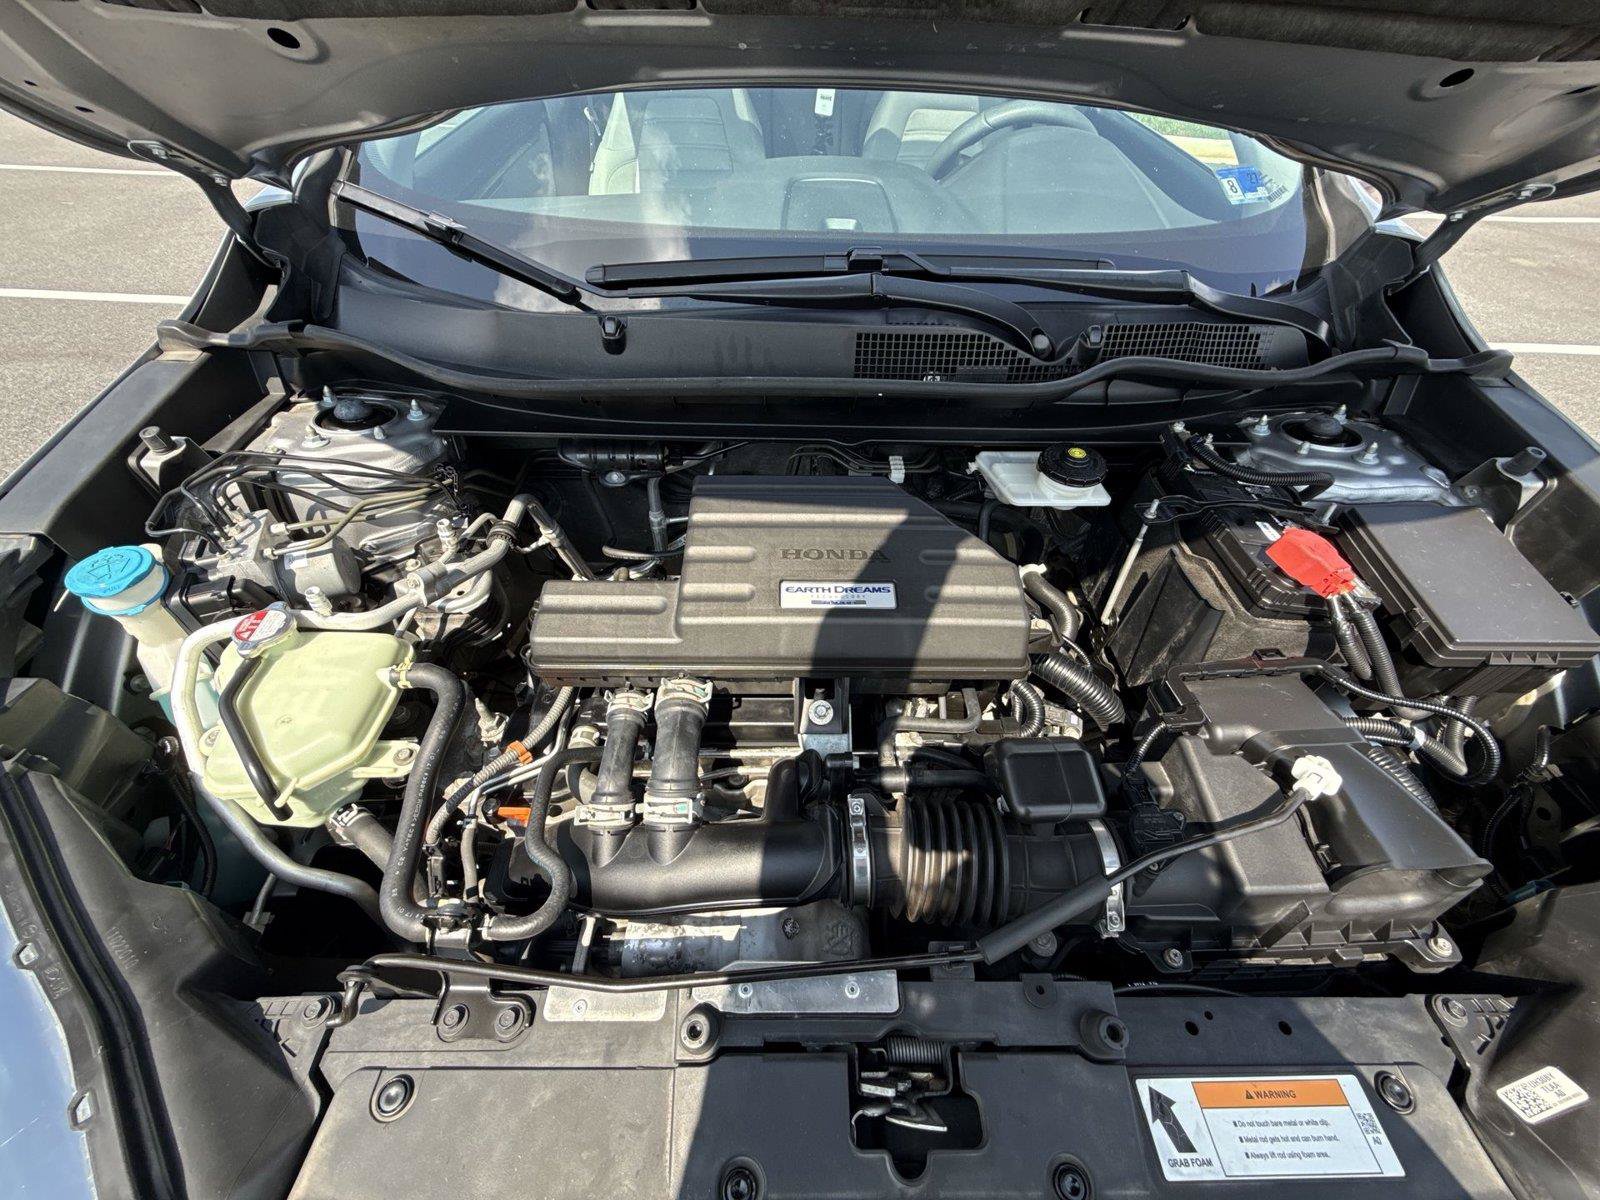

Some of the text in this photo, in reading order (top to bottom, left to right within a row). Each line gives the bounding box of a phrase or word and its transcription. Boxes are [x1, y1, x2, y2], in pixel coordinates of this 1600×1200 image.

[1227, 179, 1238, 194] 8
[780, 548, 891, 563] HONDA
[834, 585, 891, 594] DREAMS
[1254, 1089, 1297, 1100] WARNING
[1255, 1119, 1270, 1127] touch
[1270, 1119, 1283, 1127] bare
[1304, 1118, 1319, 1126] white
[1269, 1136, 1280, 1144] gets
[1311, 1134, 1324, 1142] burn
[1250, 1152, 1269, 1160] Always
[1286, 1152, 1302, 1160] using
[1167, 1157, 1214, 1168] GRAB FOAM
